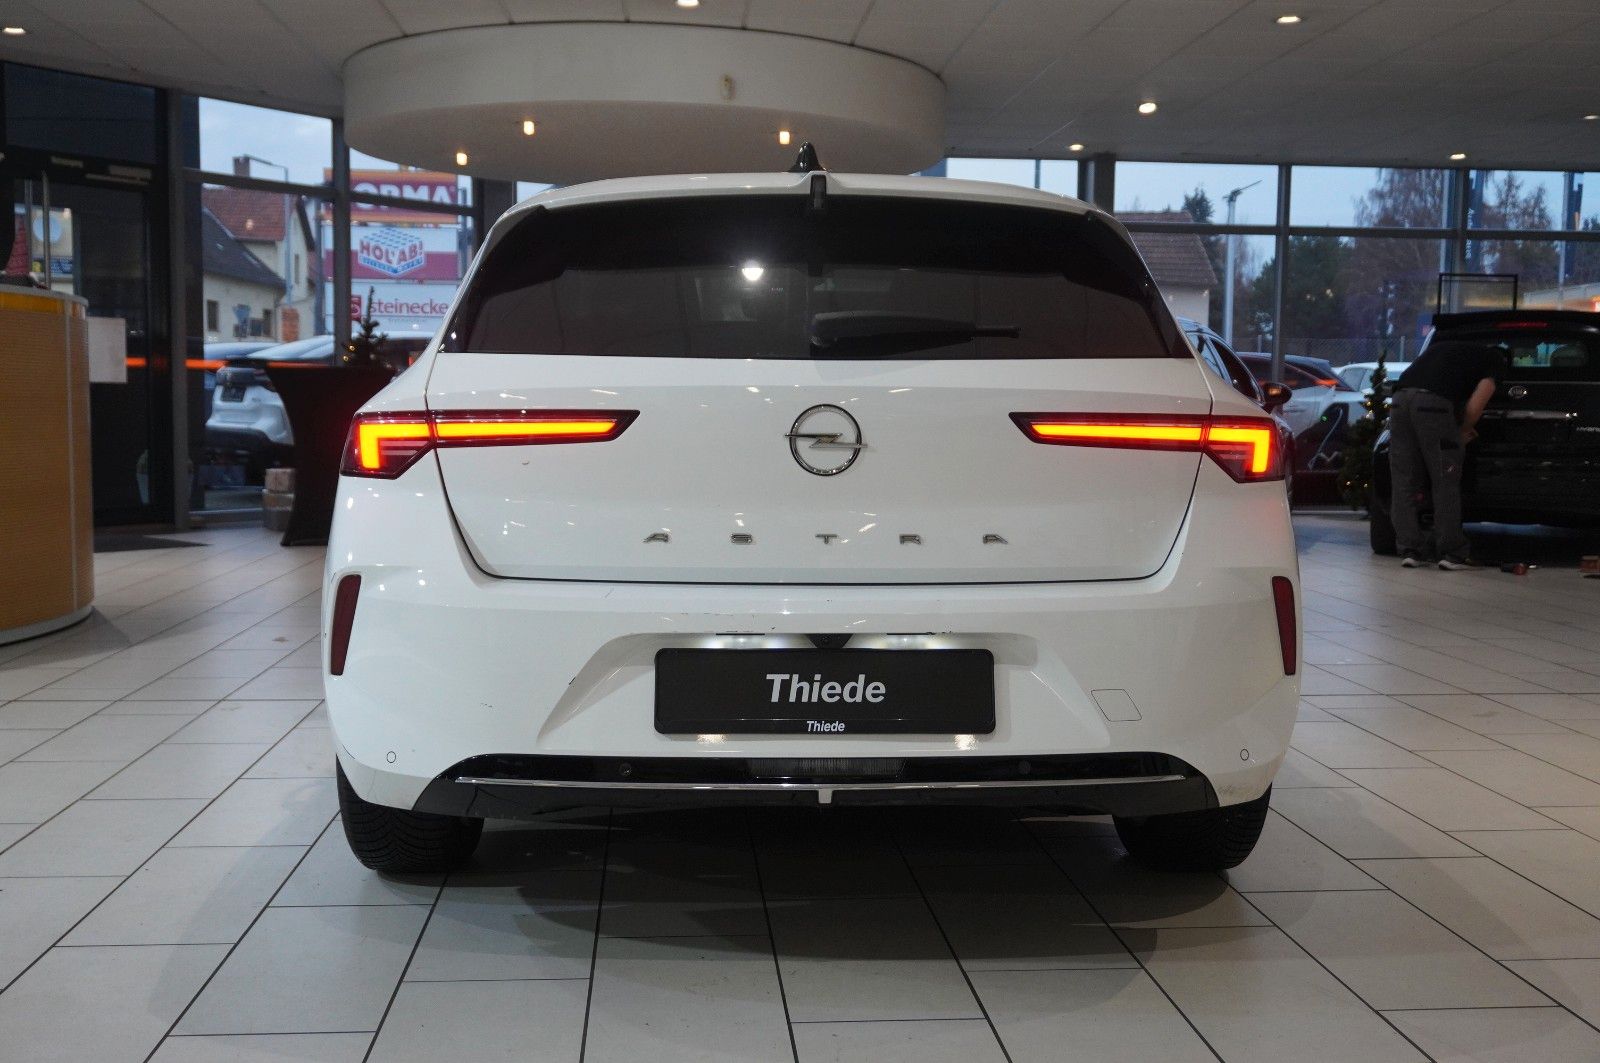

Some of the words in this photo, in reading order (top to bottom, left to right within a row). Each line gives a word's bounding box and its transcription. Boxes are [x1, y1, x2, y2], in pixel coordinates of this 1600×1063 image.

[331, 182, 451, 211] ORMA
[643, 533, 1008, 545] ASTRA
[766, 673, 886, 703] Thiede
[807, 720, 846, 732] Thiede
